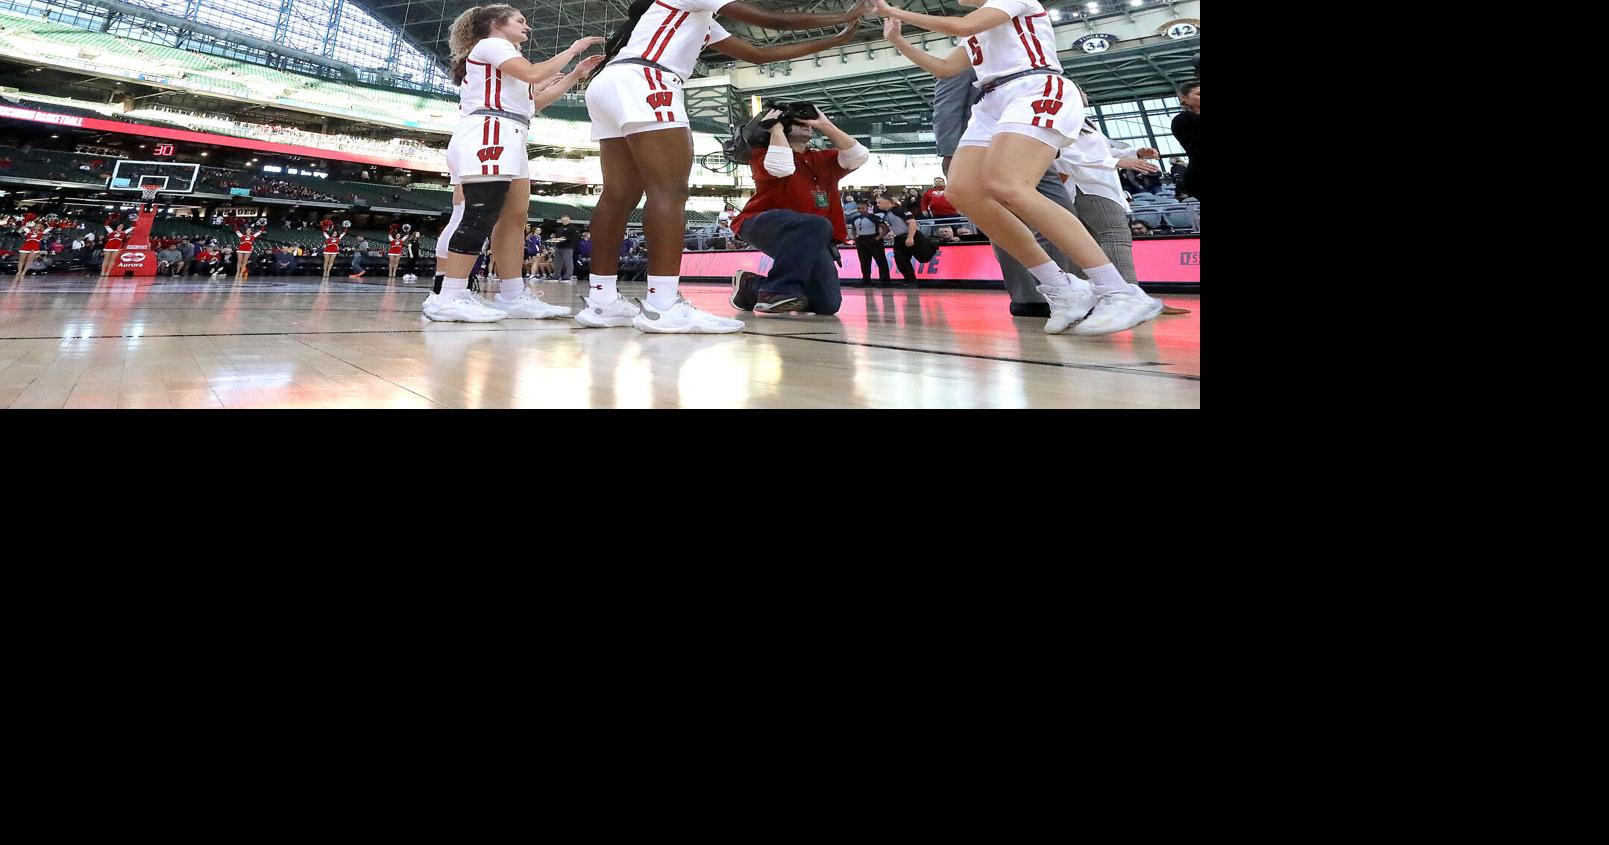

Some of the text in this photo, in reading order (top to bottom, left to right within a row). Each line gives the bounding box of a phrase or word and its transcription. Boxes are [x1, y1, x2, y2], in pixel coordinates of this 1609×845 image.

[1171, 25, 1194, 36] 42
[967, 35, 984, 66] 5
[1085, 39, 1106, 51] 34
[153, 143, 175, 156] 30
